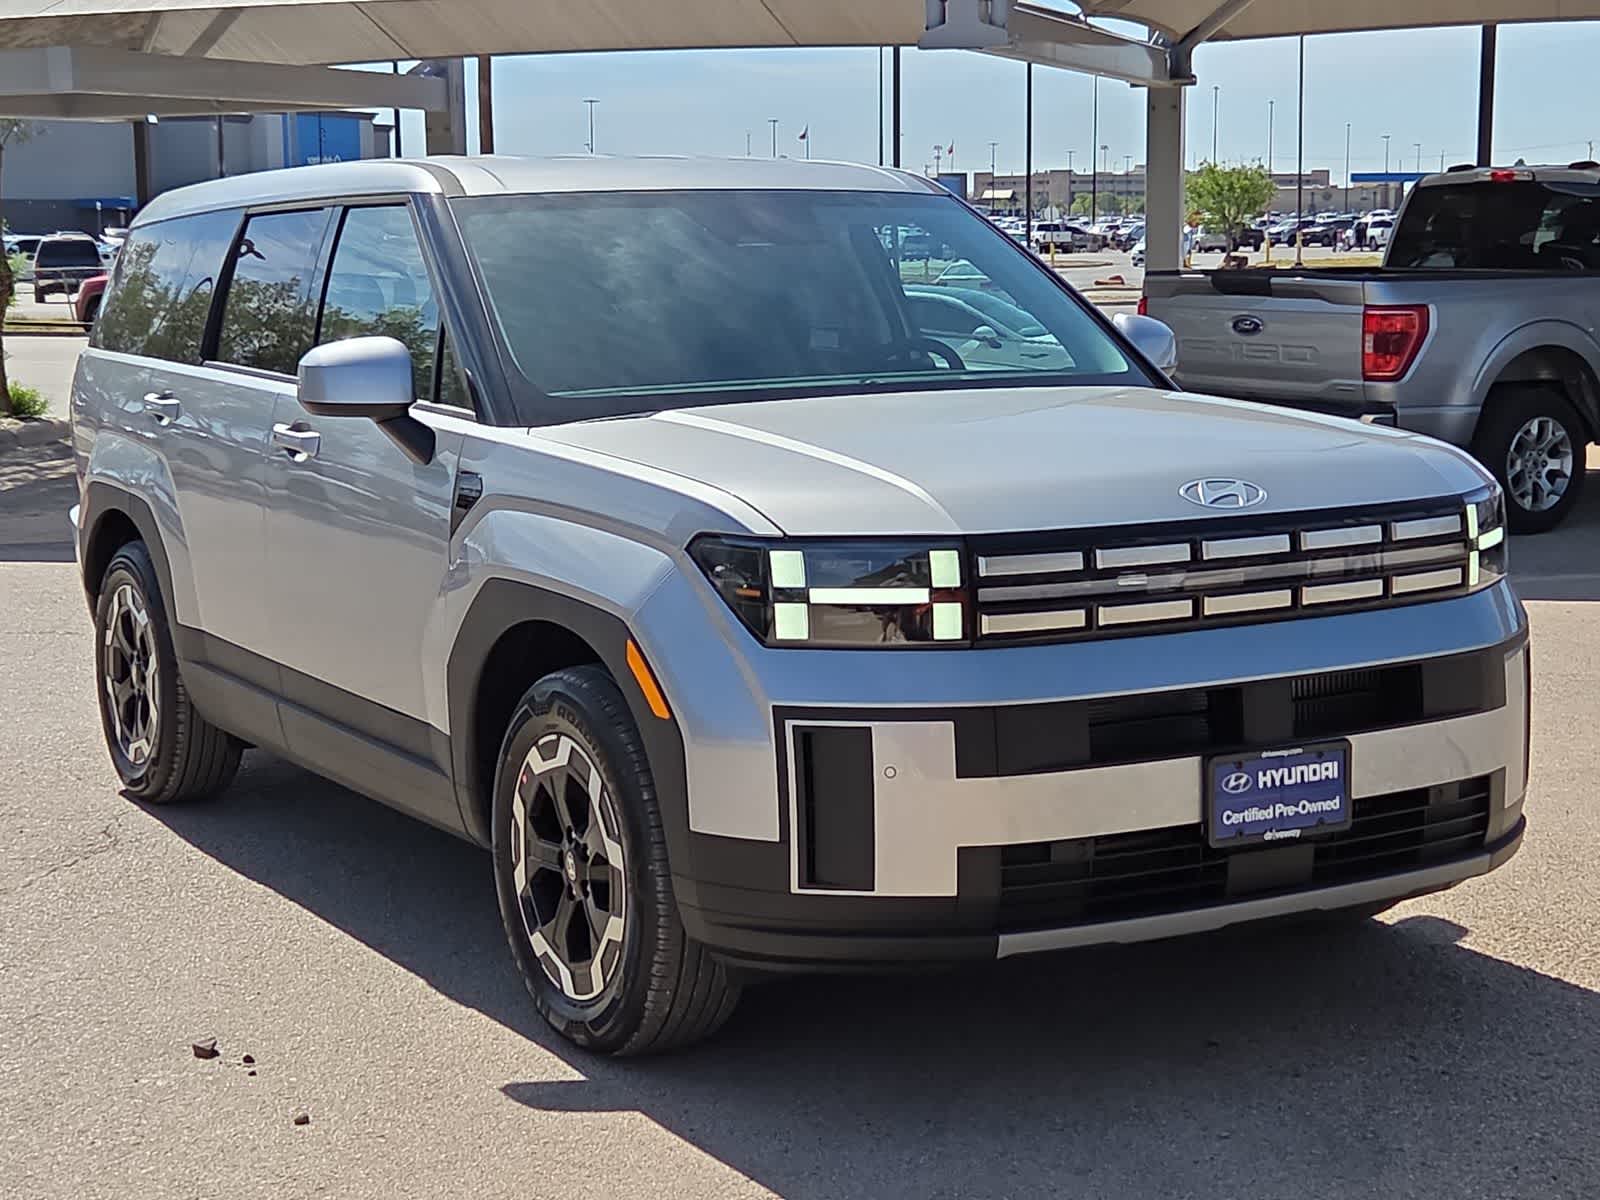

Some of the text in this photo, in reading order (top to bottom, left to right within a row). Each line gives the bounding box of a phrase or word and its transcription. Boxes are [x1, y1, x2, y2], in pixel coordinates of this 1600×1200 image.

[1258, 761, 1339, 789] HYUNDAI
[1222, 796, 1340, 825] Certified Pre-Owned
